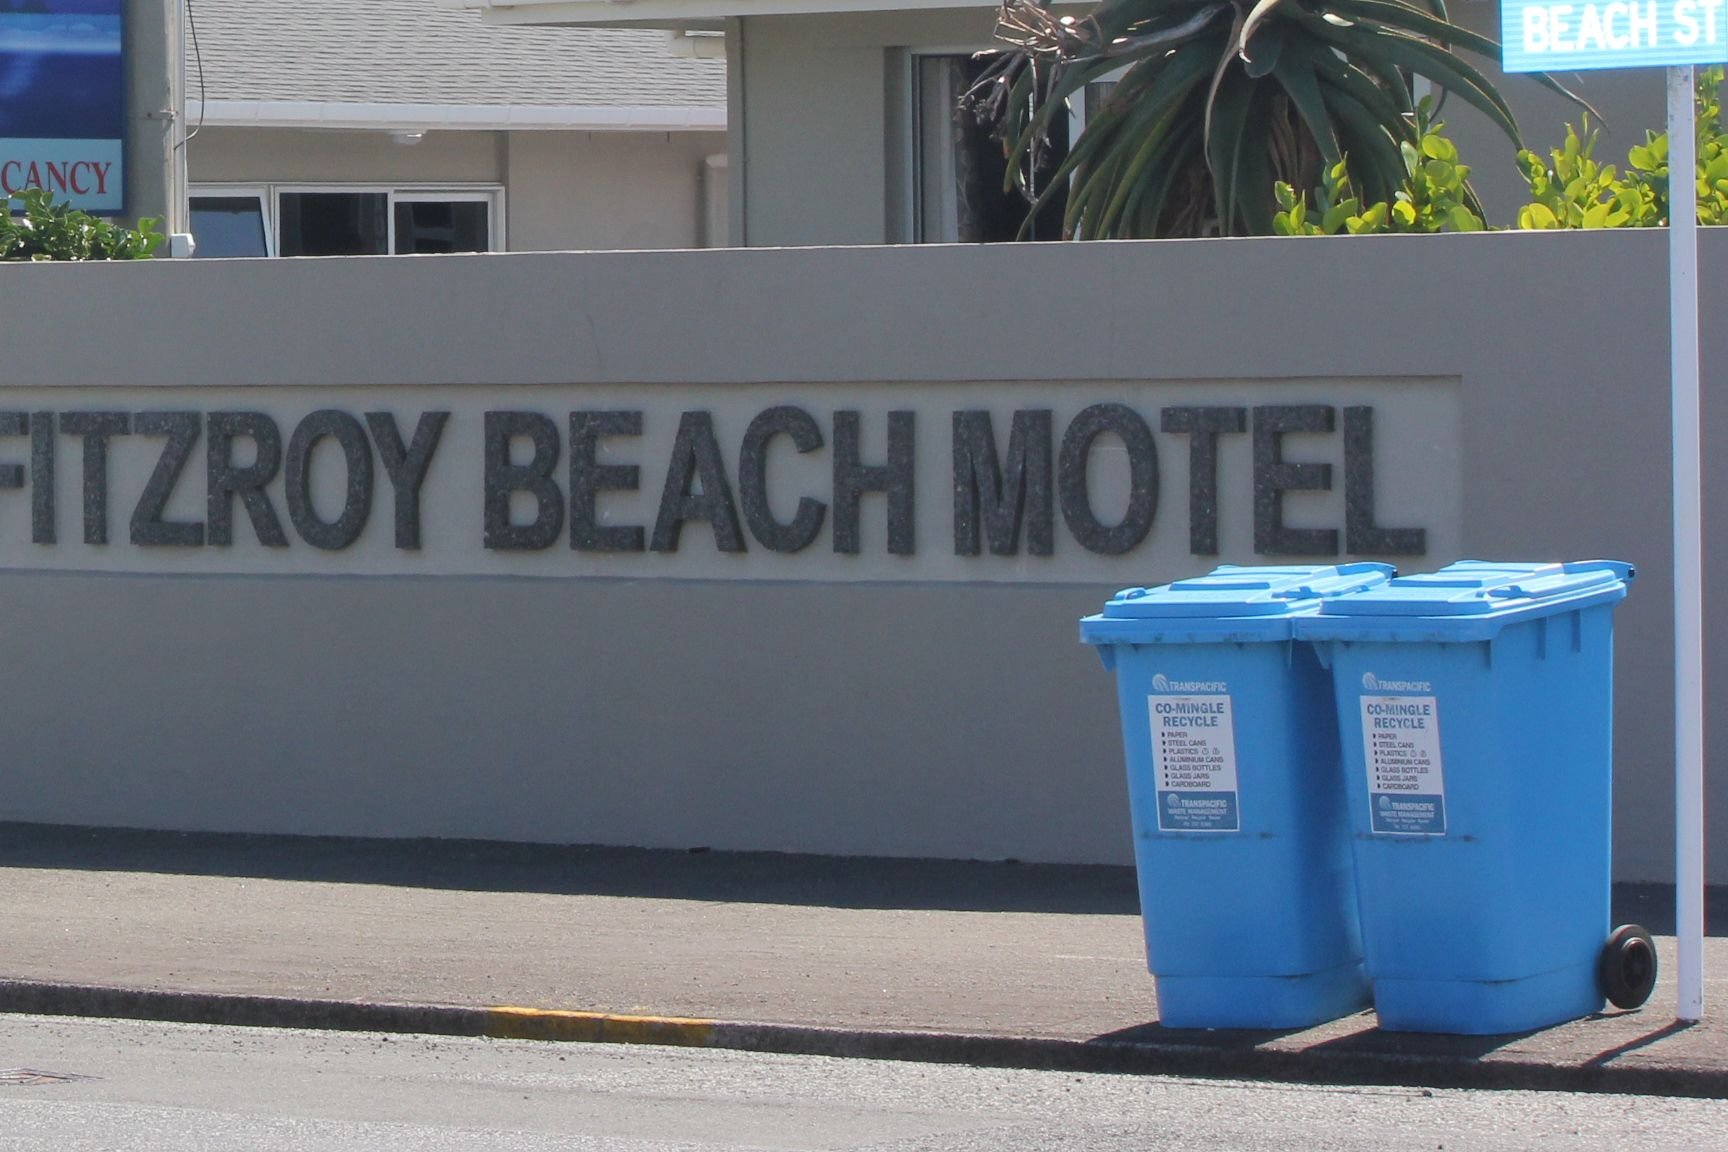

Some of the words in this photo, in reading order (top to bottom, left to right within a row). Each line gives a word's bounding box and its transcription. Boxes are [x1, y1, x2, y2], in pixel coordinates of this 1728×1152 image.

[1523, 0, 1658, 53] BEACH
[483, 405, 916, 555] BEACH
[952, 403, 1427, 556] MOTEL
[1169, 681, 1227, 692] TRANSPACIFIC
[1378, 680, 1431, 692] TRANSPACIFIC
[1155, 702, 1225, 714] CO-MINGLE
[1367, 703, 1431, 716] CO-MINGLE
[1163, 716, 1219, 727] RECYCLE
[1374, 717, 1425, 729] RECYCLE
